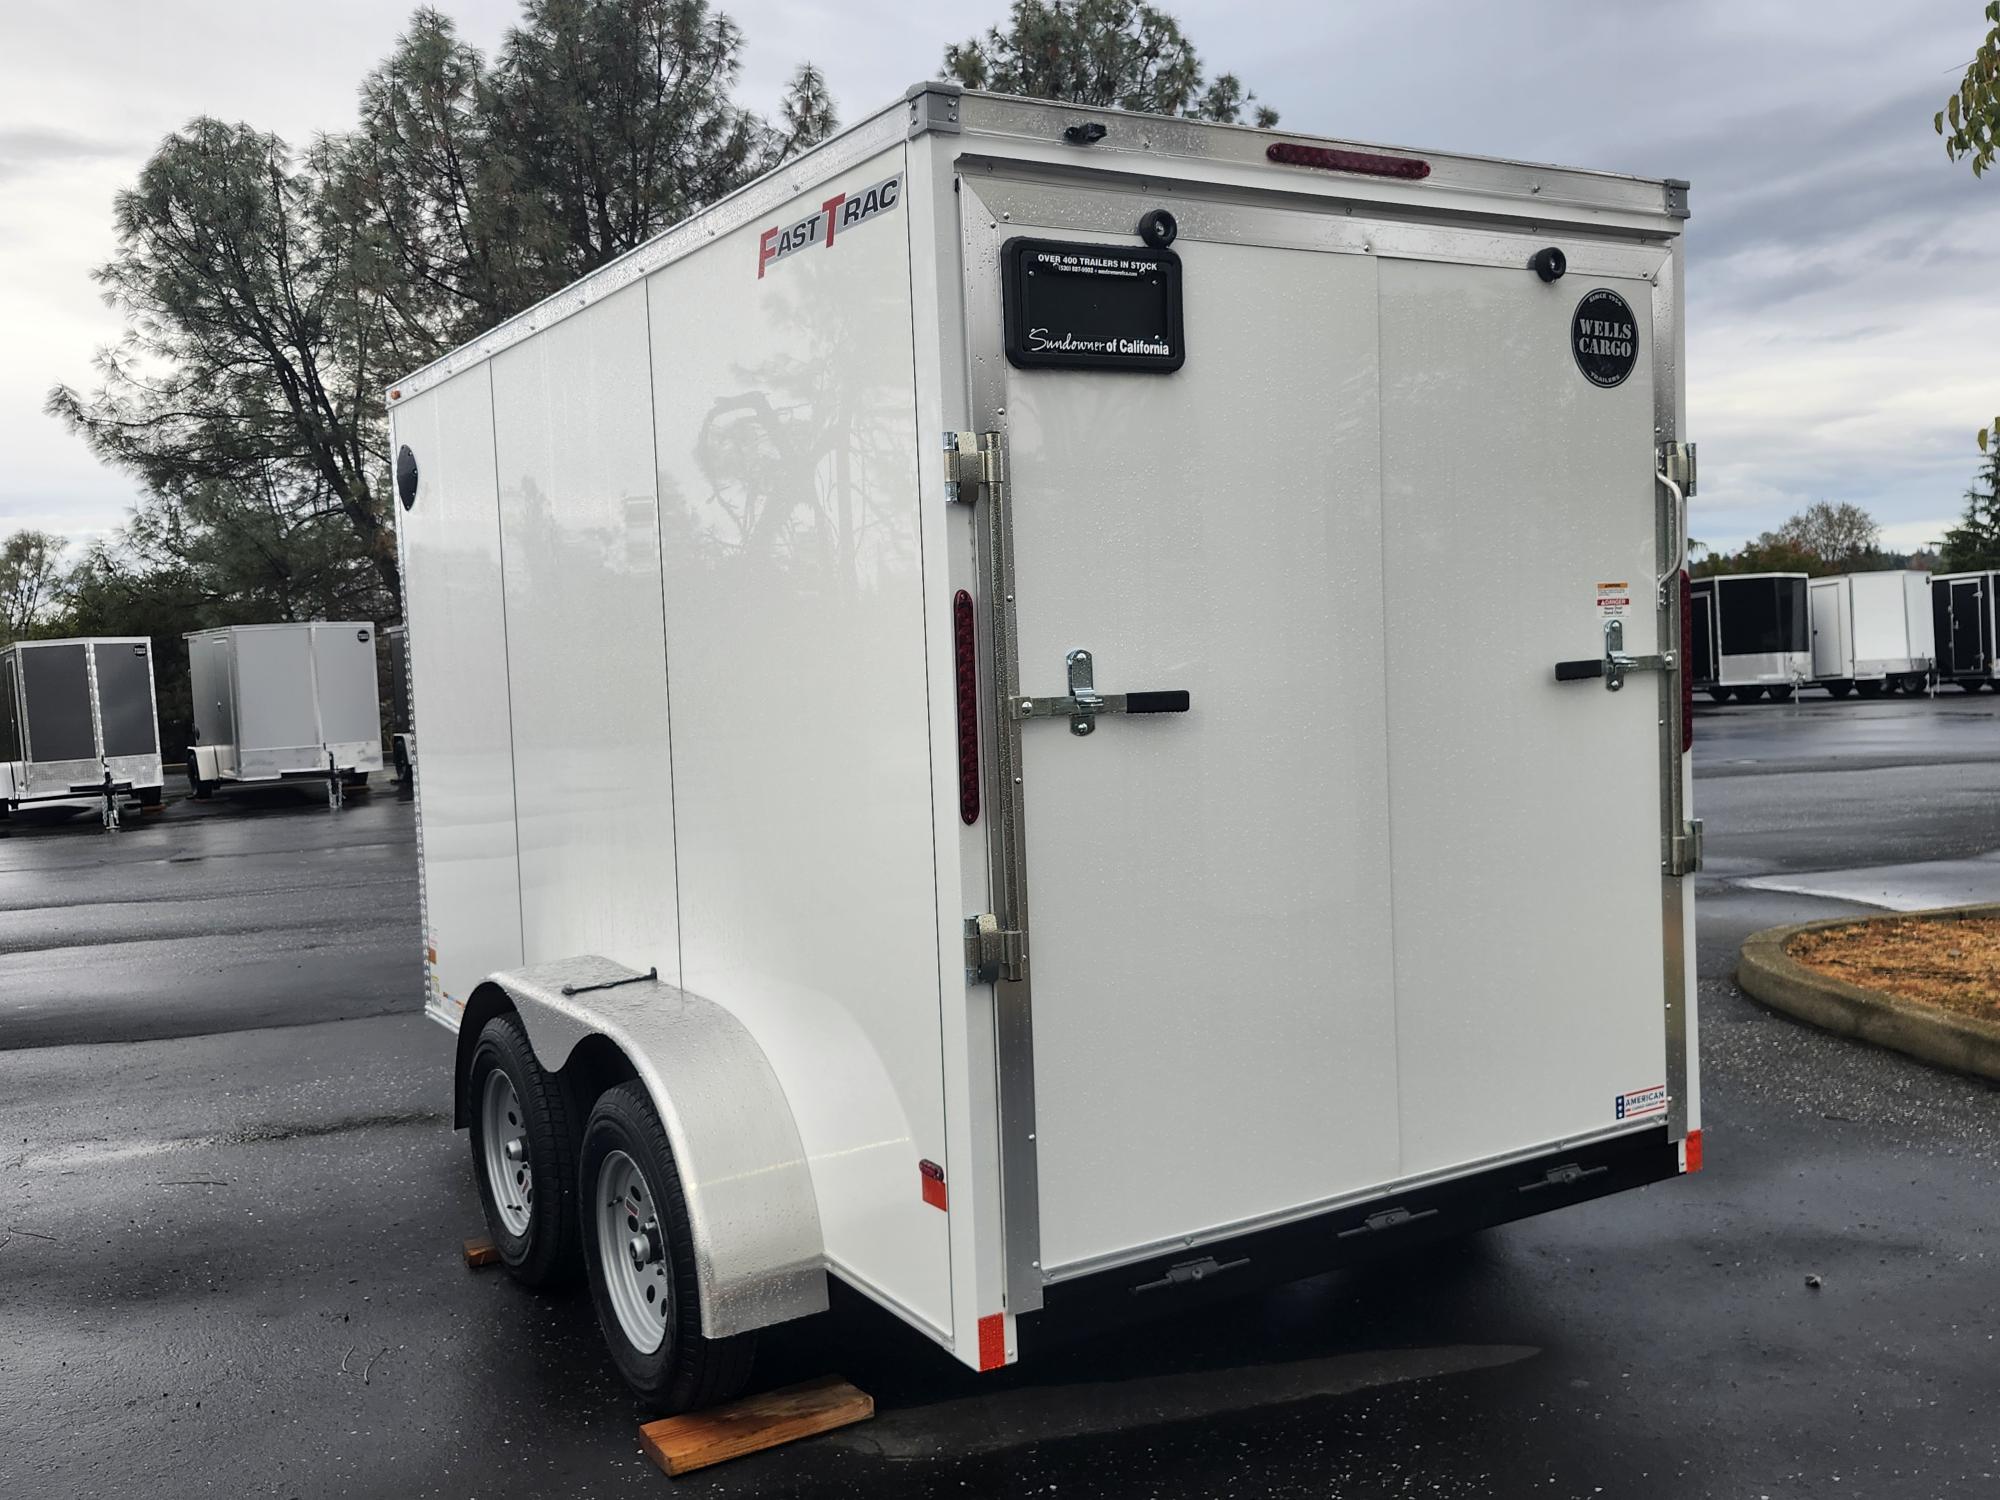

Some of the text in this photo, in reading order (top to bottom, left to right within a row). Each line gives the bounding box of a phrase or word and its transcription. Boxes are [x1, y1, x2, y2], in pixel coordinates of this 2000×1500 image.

[1038, 254, 1158, 271] OVER 400 TRAILERS IN STOCK
[1580, 319, 1632, 340] WELLS
[1028, 328, 1169, 356] Sundowner of California
[1579, 337, 1632, 358] CARGO
[1625, 1091, 1664, 1106] AMERICAN
